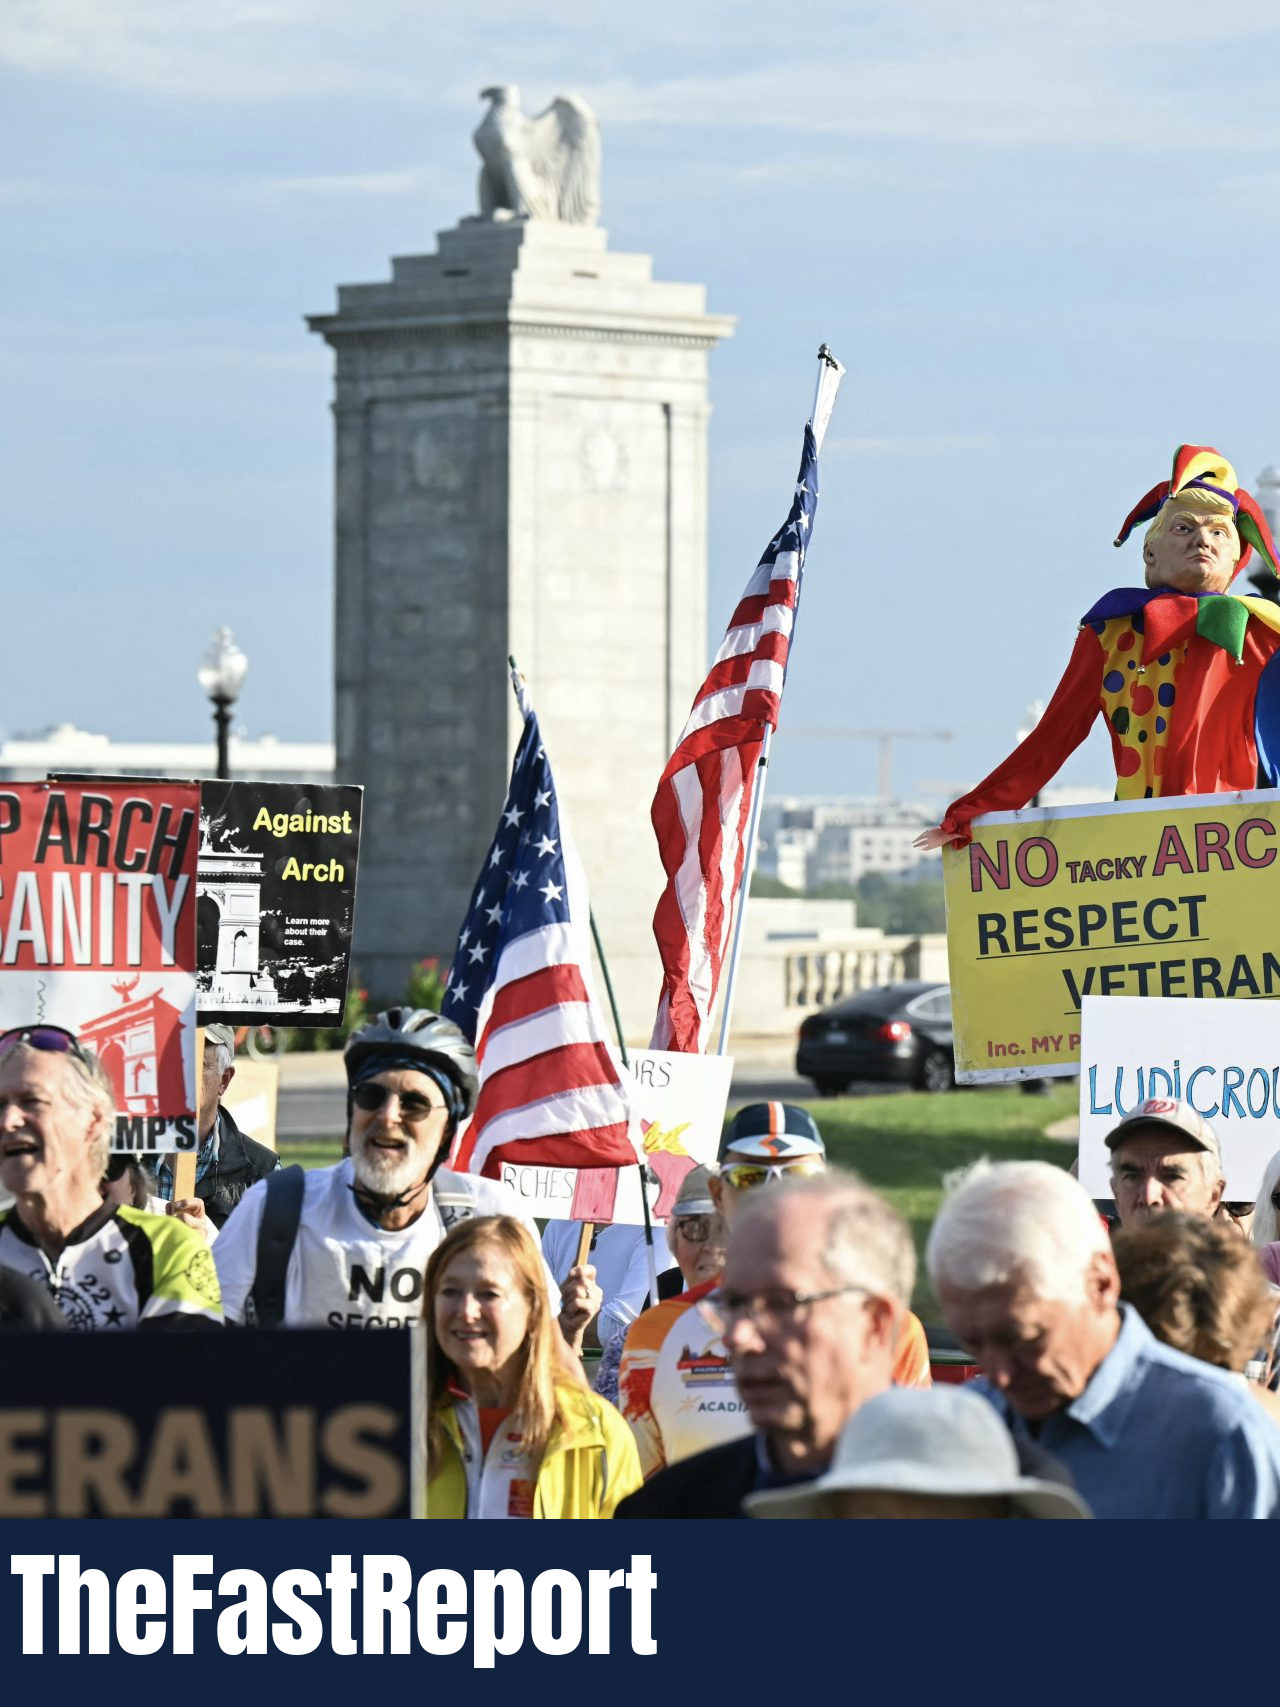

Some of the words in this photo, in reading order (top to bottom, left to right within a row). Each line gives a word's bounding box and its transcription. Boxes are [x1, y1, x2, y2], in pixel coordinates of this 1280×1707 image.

[33, 791, 195, 881] ARCH
[252, 806, 353, 838] Against
[281, 856, 345, 883] Arch
[968, 836, 1059, 892] NO
[1065, 855, 1147, 883] TACKY
[0, 872, 190, 967] ANITY
[284, 927, 308, 936] about
[309, 927, 328, 936] their
[285, 916, 308, 925] Learn
[310, 918, 330, 926] more
[977, 894, 1207, 956] RESPECT
[987, 1040, 1026, 1058] Inc.
[1031, 1034, 1064, 1054] MY
[109, 1114, 196, 1151] MP'S
[348, 1264, 423, 1303] NO
